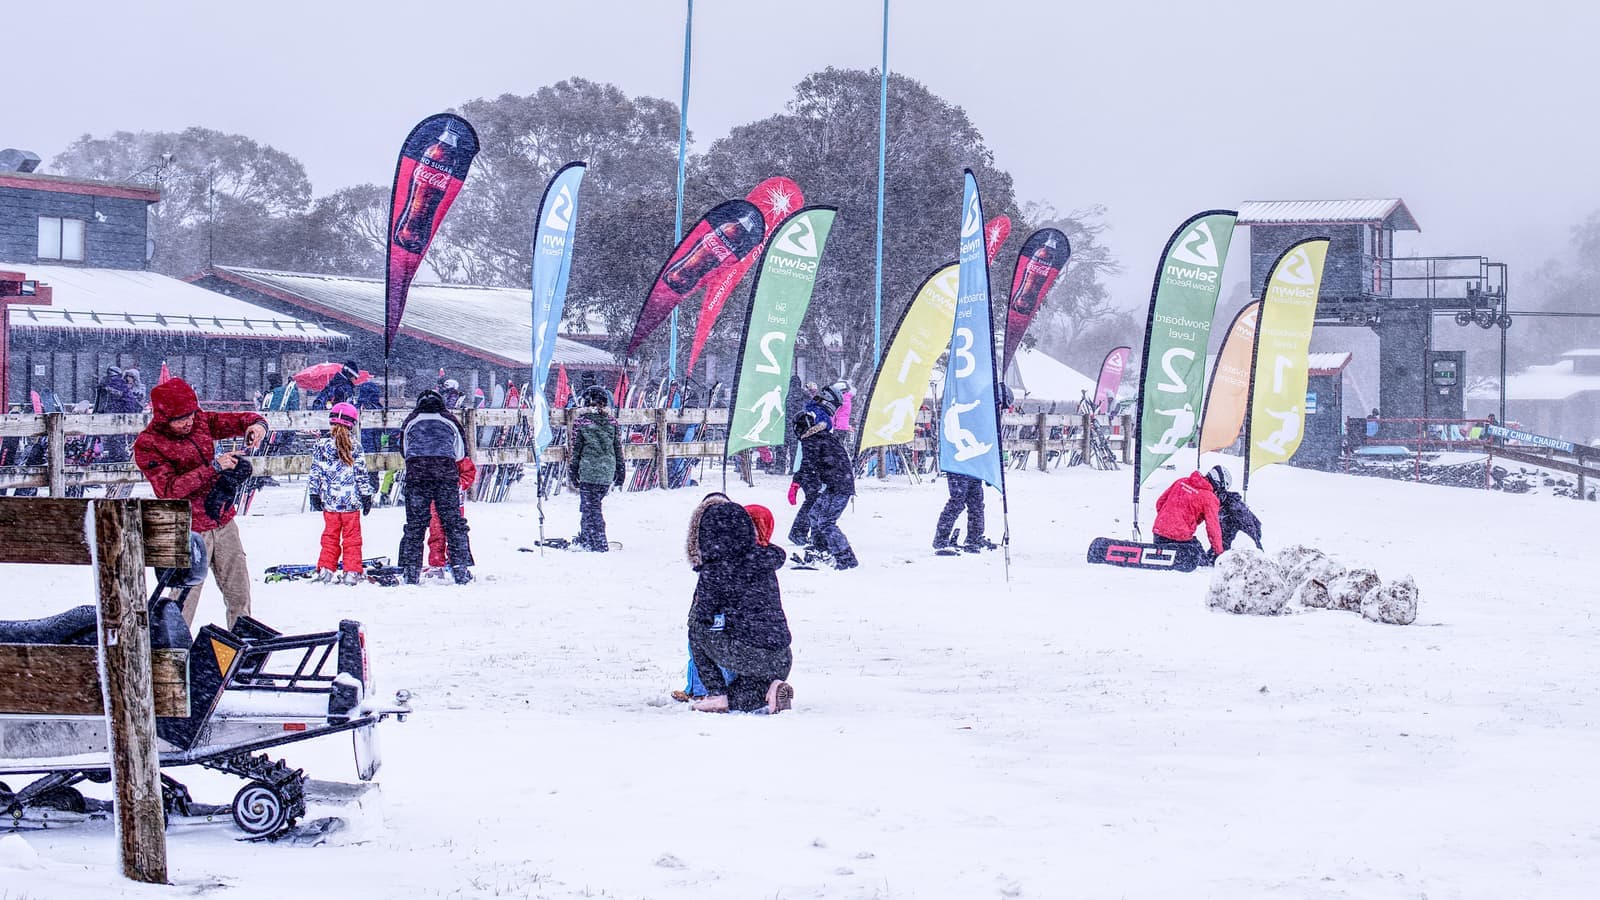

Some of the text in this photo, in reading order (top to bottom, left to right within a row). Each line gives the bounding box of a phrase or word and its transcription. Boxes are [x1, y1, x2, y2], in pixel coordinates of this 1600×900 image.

[958, 292, 986, 304] wboard
[957, 308, 972, 318] evel
[955, 327, 976, 379] 3
[1492, 426, 1570, 451] NEW CHUM CHAIRLIFT
